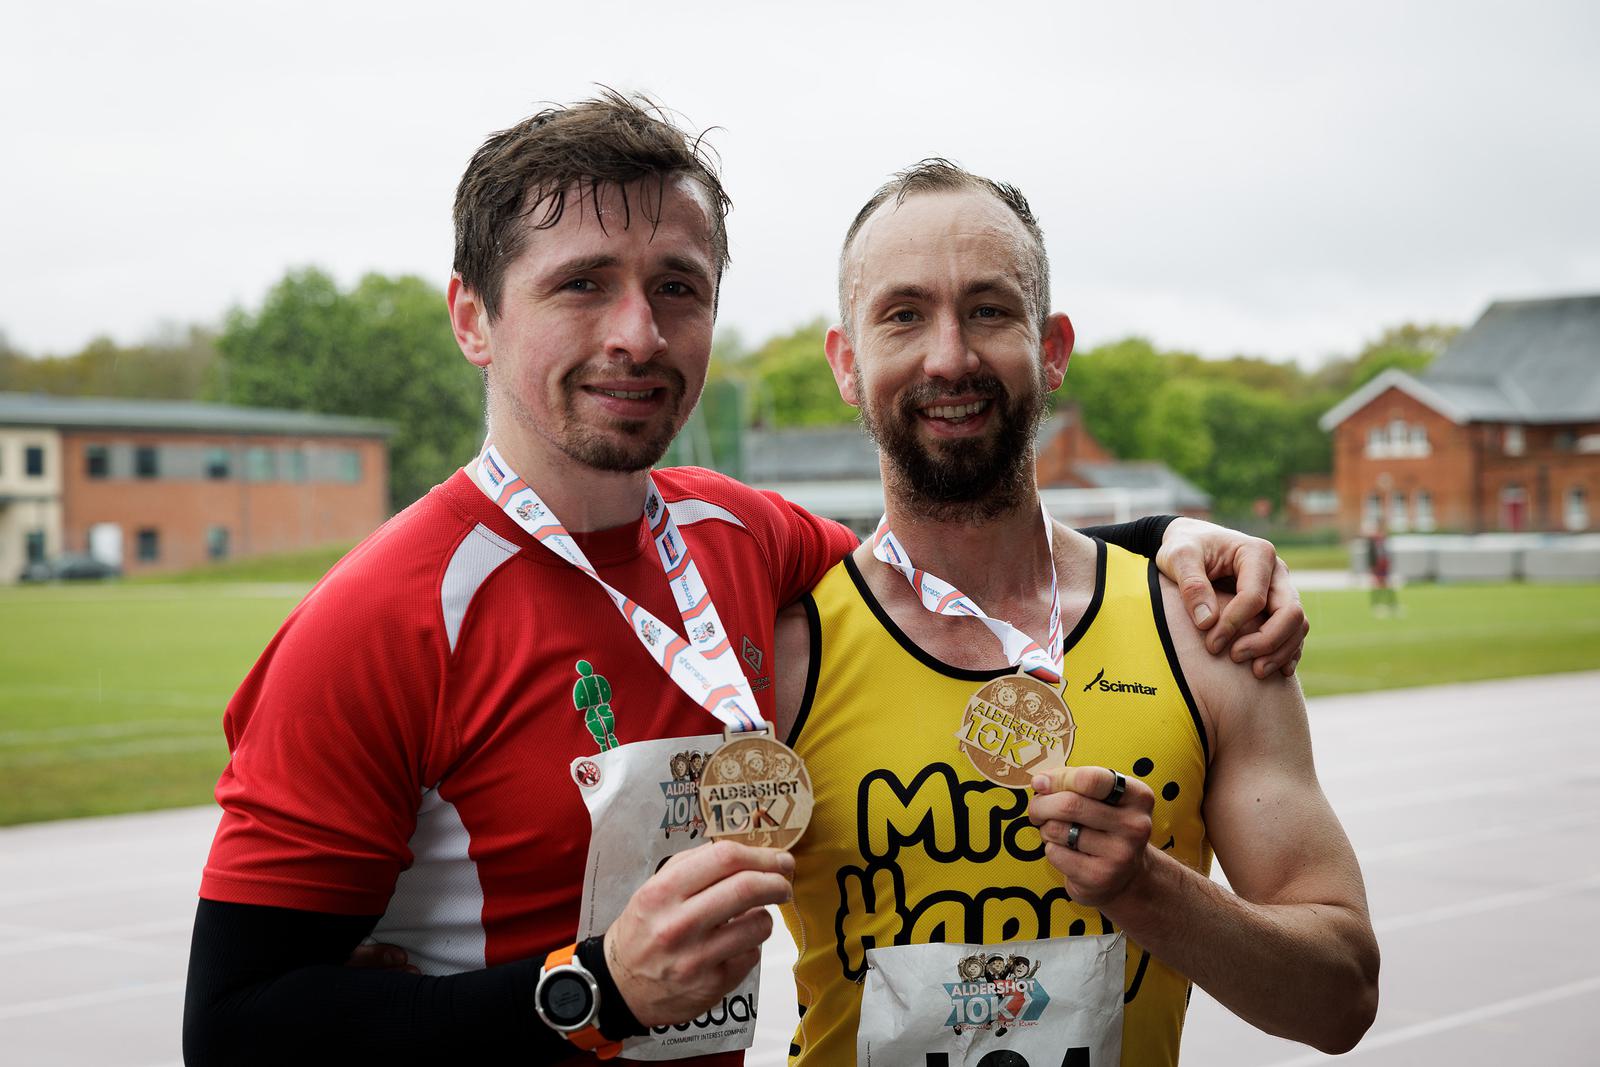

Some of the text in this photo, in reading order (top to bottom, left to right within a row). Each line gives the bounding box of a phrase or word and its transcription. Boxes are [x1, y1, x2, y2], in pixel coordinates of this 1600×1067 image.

[1099, 679, 1158, 696] Scimitar
[973, 701, 1061, 751] ALDERSHOT
[965, 713, 1028, 769] 10K
[709, 781, 798, 801] ALDERSHOT
[710, 799, 779, 833] 10K
[952, 980, 1035, 996] ALDERSHOT
[952, 995, 1015, 1023] 10K
[666, 1034, 700, 1046] COMMUNITY
[700, 1031, 724, 1041] INTEREST
